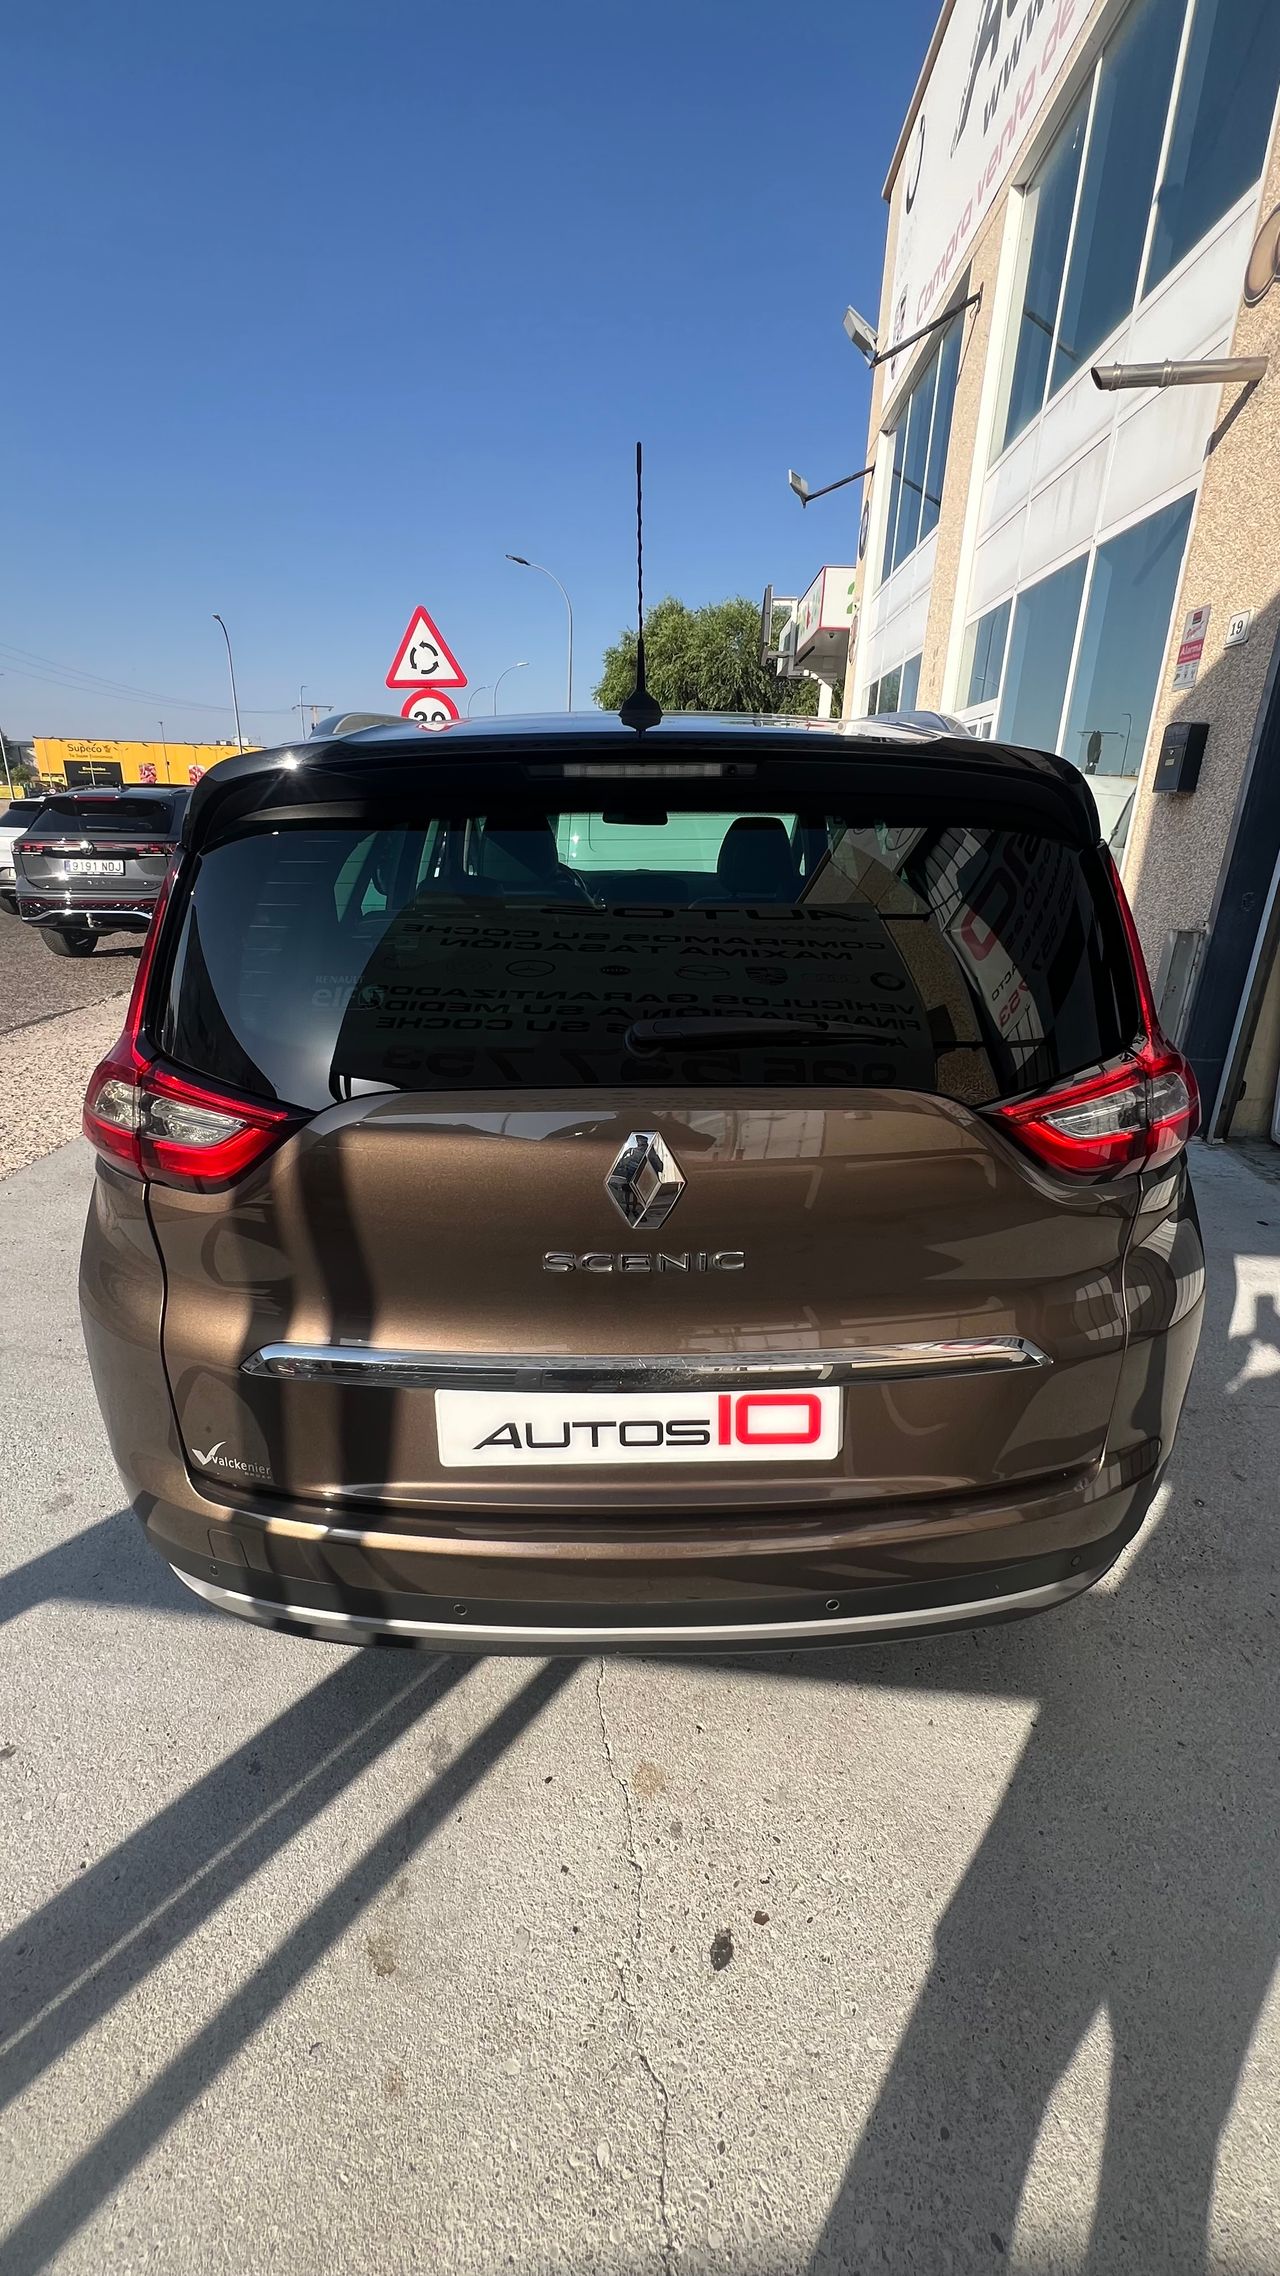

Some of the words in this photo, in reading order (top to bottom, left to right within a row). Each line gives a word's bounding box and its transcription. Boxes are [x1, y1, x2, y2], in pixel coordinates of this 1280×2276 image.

[916, 197, 973, 326] compra
[978, 64, 1037, 206] venta
[1229, 620, 1244, 637] 19
[67, 743, 102, 753] Supeco
[72, 861, 97, 872] 9191
[315, 975, 366, 985] RENAULT
[542, 1251, 745, 1273] SCENIC
[211, 1456, 271, 1475] valckenier
